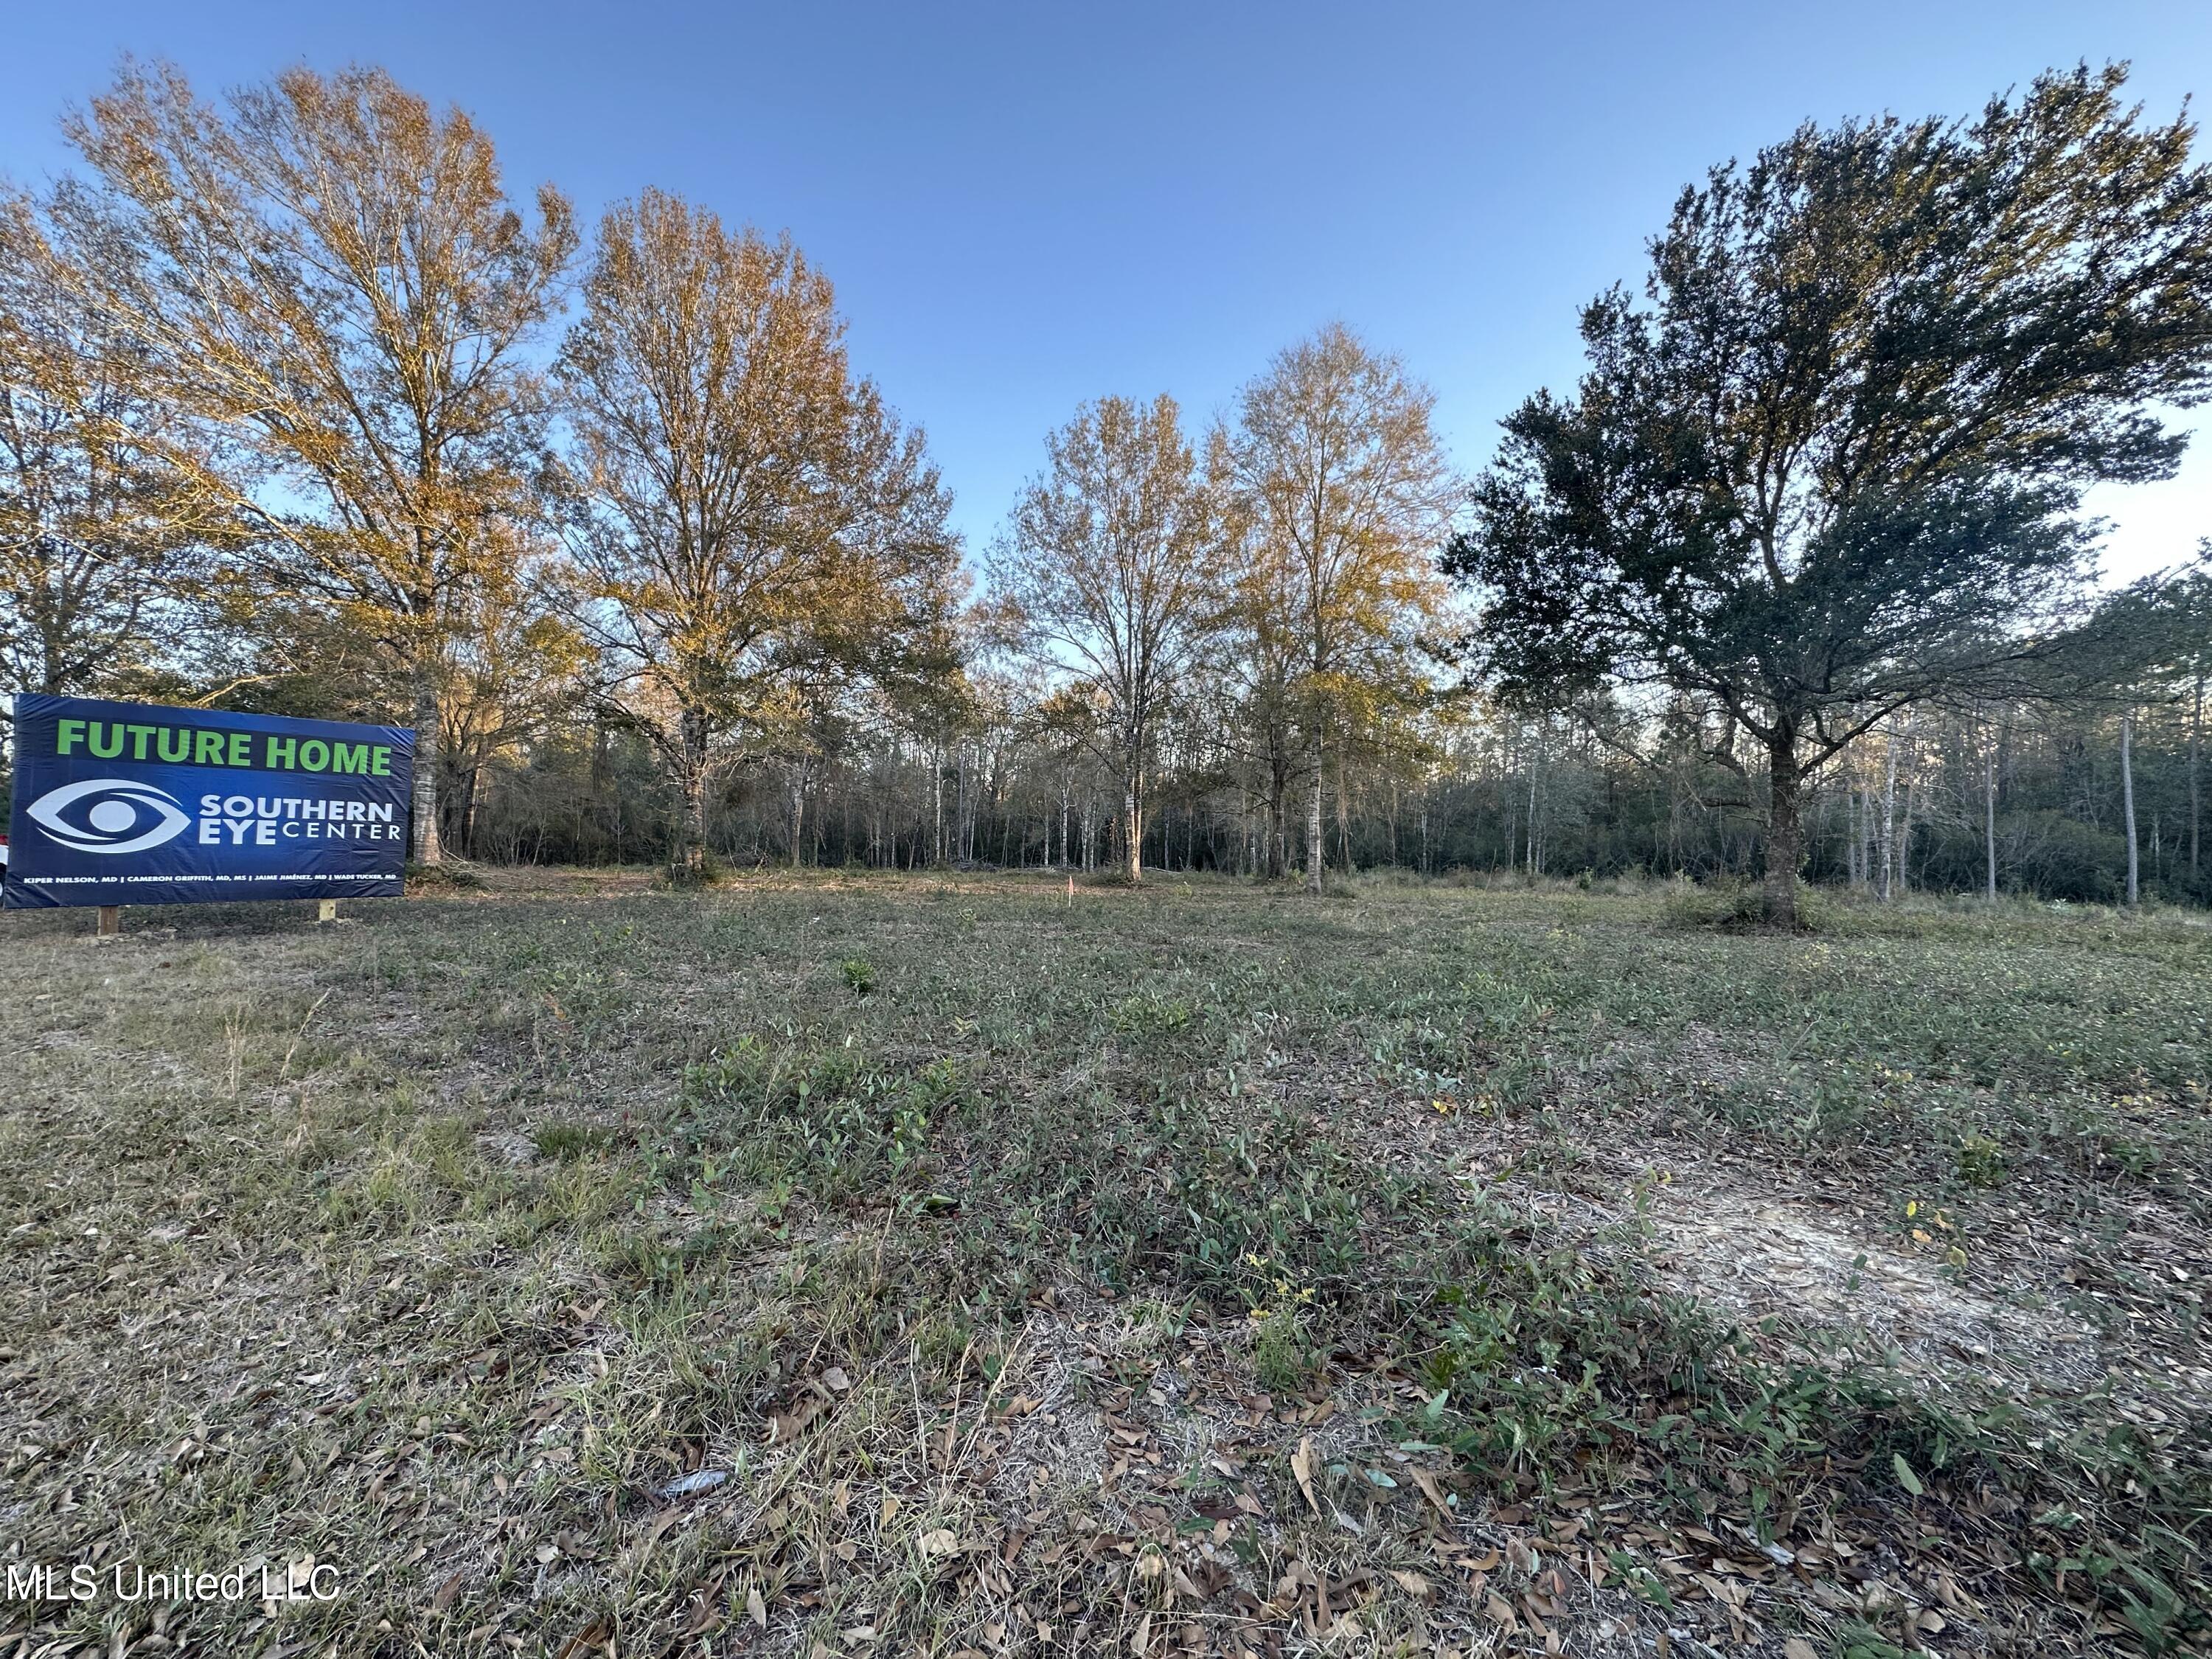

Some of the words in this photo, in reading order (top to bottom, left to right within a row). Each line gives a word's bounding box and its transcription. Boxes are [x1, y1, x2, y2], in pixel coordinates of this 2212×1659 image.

[58, 719, 251, 767] FUTURE
[266, 737, 392, 776] HOME
[199, 794, 393, 822] SOUTHERN
[199, 818, 277, 845] EYE
[282, 821, 400, 840] CENTER
